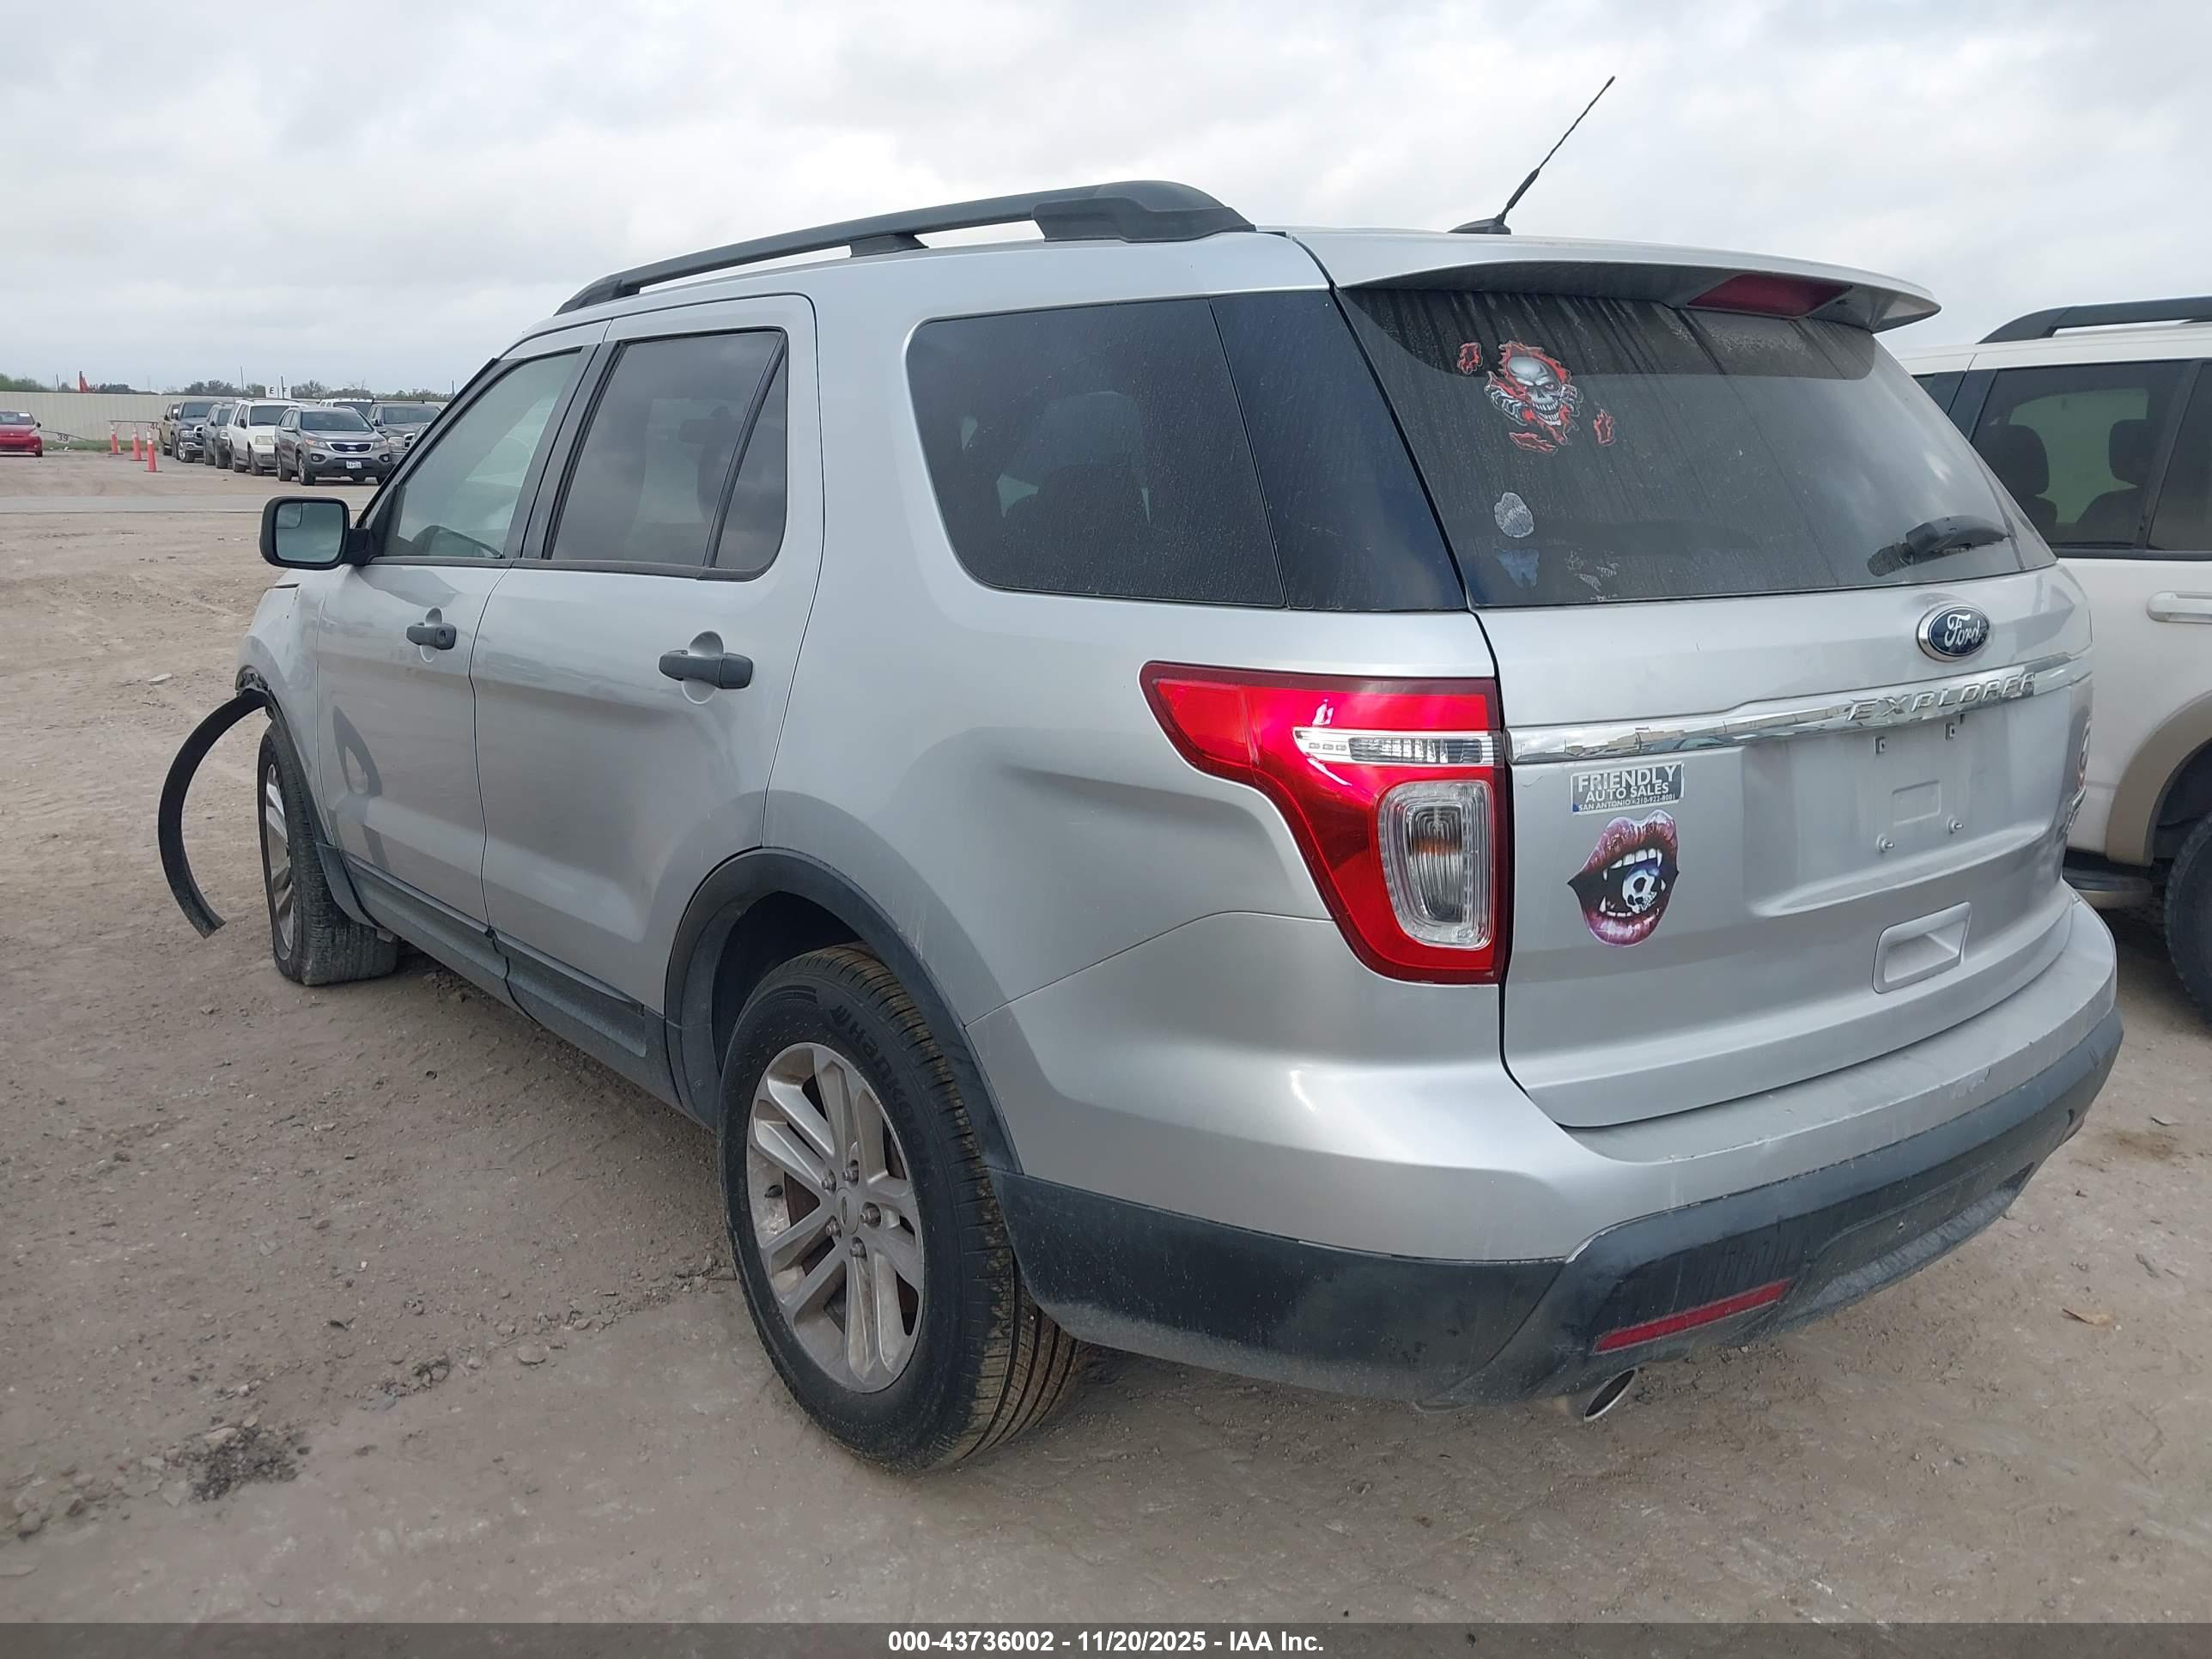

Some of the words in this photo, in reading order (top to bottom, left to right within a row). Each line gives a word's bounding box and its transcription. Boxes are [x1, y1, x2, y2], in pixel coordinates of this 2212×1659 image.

[57, 433, 69, 442] 39
[1944, 612, 1982, 647] Ford
[1846, 672, 2036, 722] EXPLORER
[1577, 765, 1677, 793] FRIENDLY
[1585, 787, 1626, 803] AUTO
[1630, 782, 1669, 798] SALES
[1578, 802, 1595, 811] SAN
[1595, 799, 1631, 810] ANTONIO
